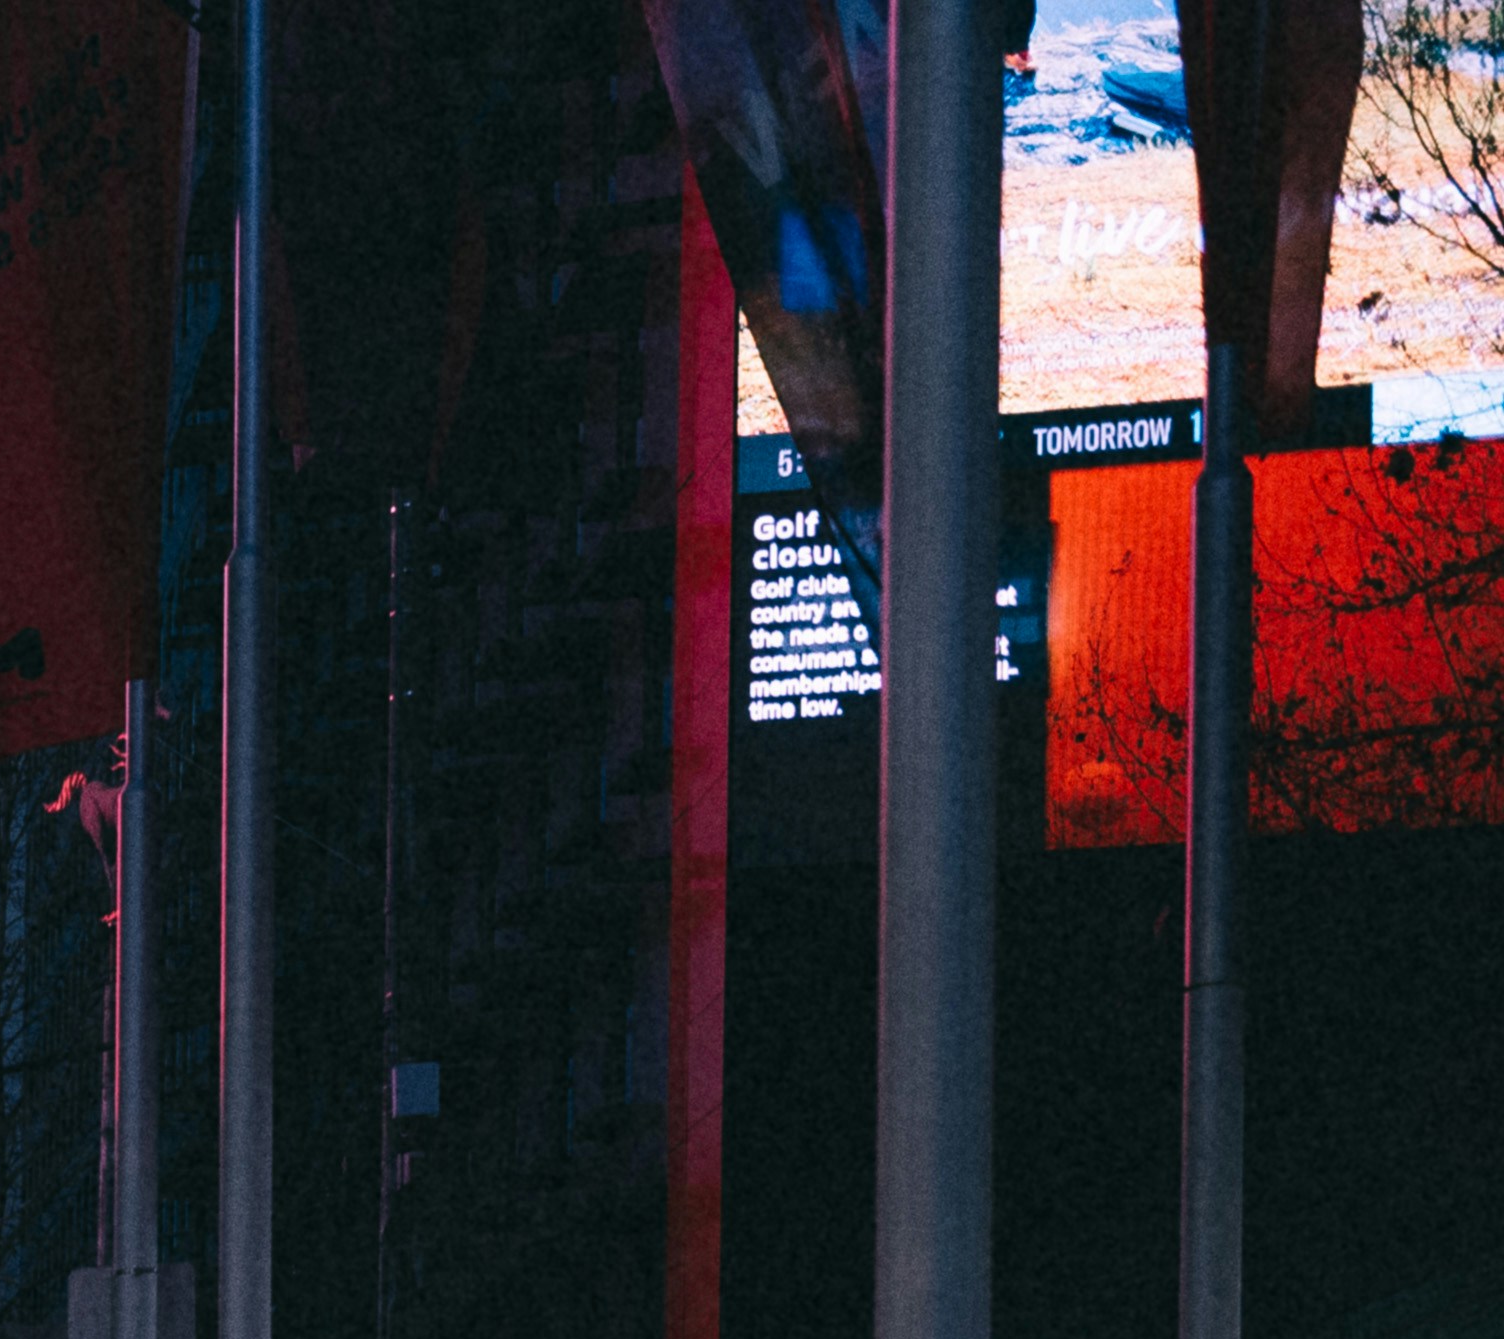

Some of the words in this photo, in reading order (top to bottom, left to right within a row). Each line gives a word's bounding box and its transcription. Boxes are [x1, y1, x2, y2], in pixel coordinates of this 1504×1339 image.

[1033, 418, 1172, 456] TOMORROW
[753, 510, 820, 541] Golf
[750, 576, 794, 600] Golf
[797, 573, 850, 597] clubs
[750, 601, 826, 624] country
[749, 628, 784, 649] the
[789, 623, 849, 647] needs
[750, 649, 857, 674] consumers
[749, 670, 882, 699] memberships
[748, 699, 796, 722] time
[800, 696, 844, 719] low.
